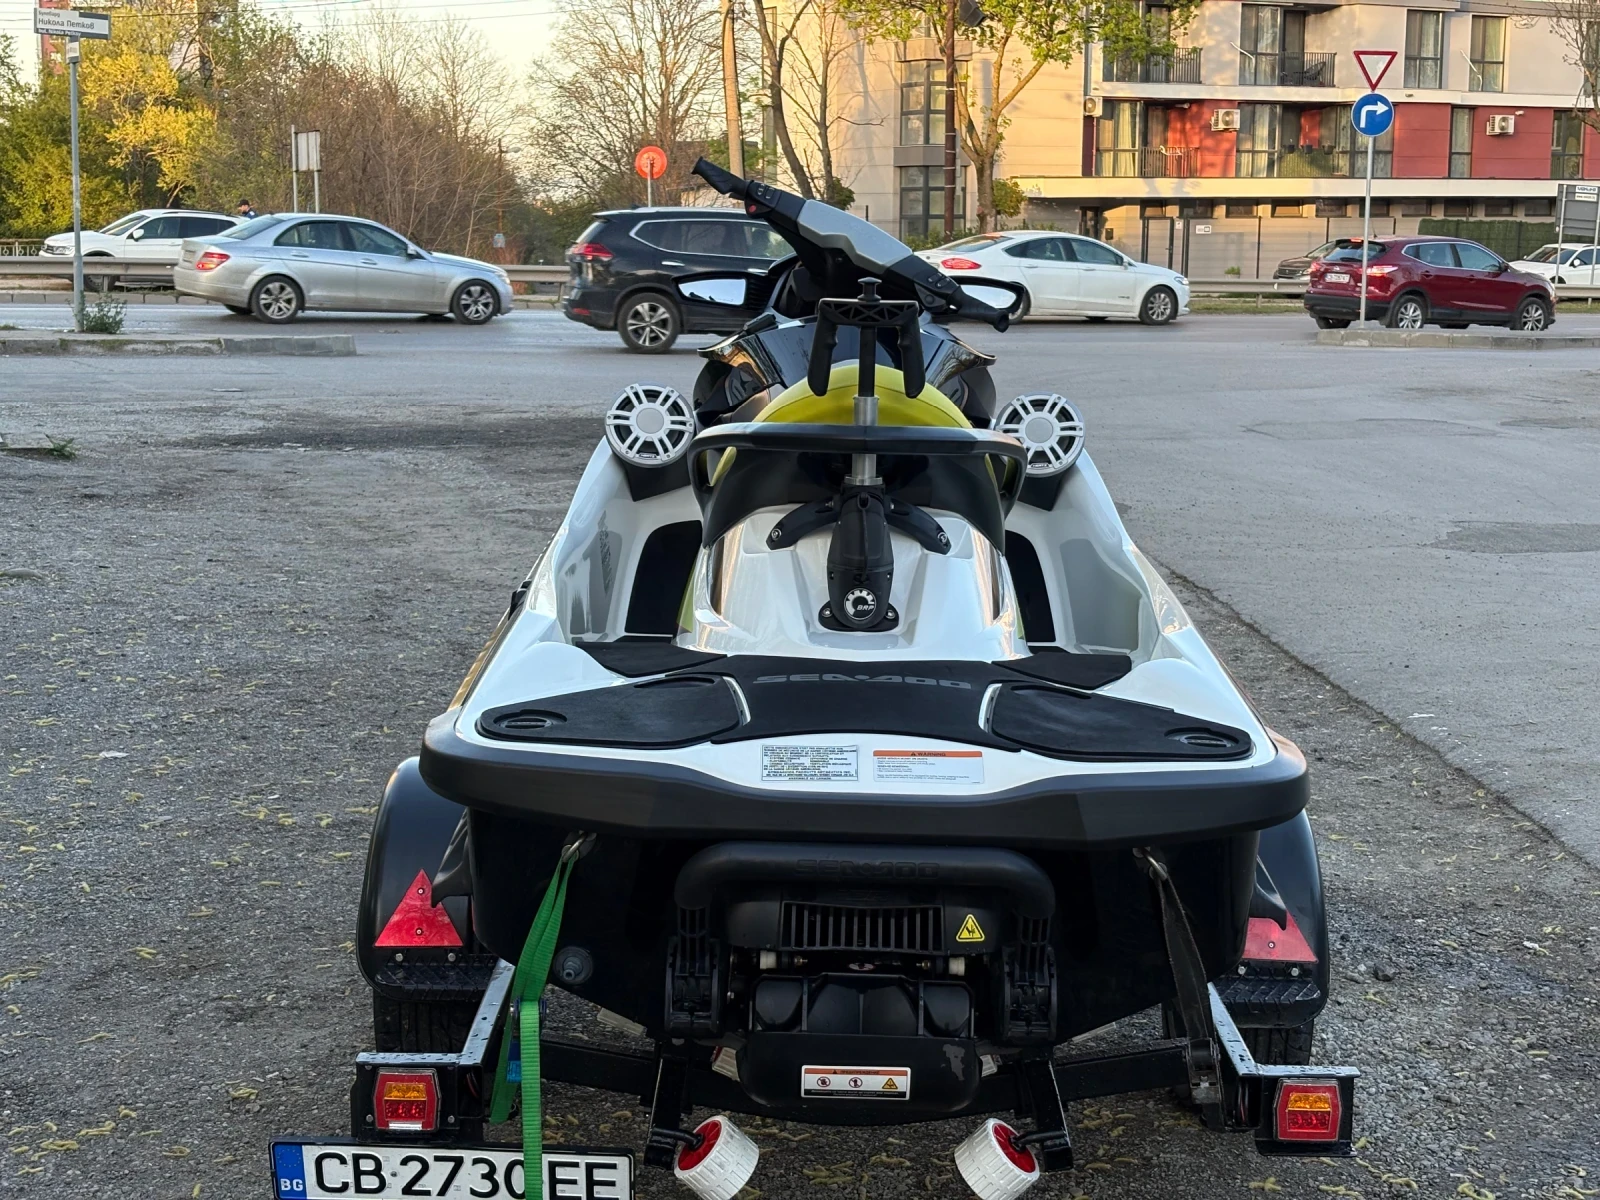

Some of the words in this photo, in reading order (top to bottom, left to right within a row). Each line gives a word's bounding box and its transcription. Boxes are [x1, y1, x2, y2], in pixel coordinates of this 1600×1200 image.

[38, 18, 65, 27] Никола
[66, 20, 95, 29] Петков
[314, 1152, 387, 1195] CB
[398, 1154, 526, 1199] 2730
[547, 1160, 619, 1200] EE
[280, 1177, 305, 1193] BG
